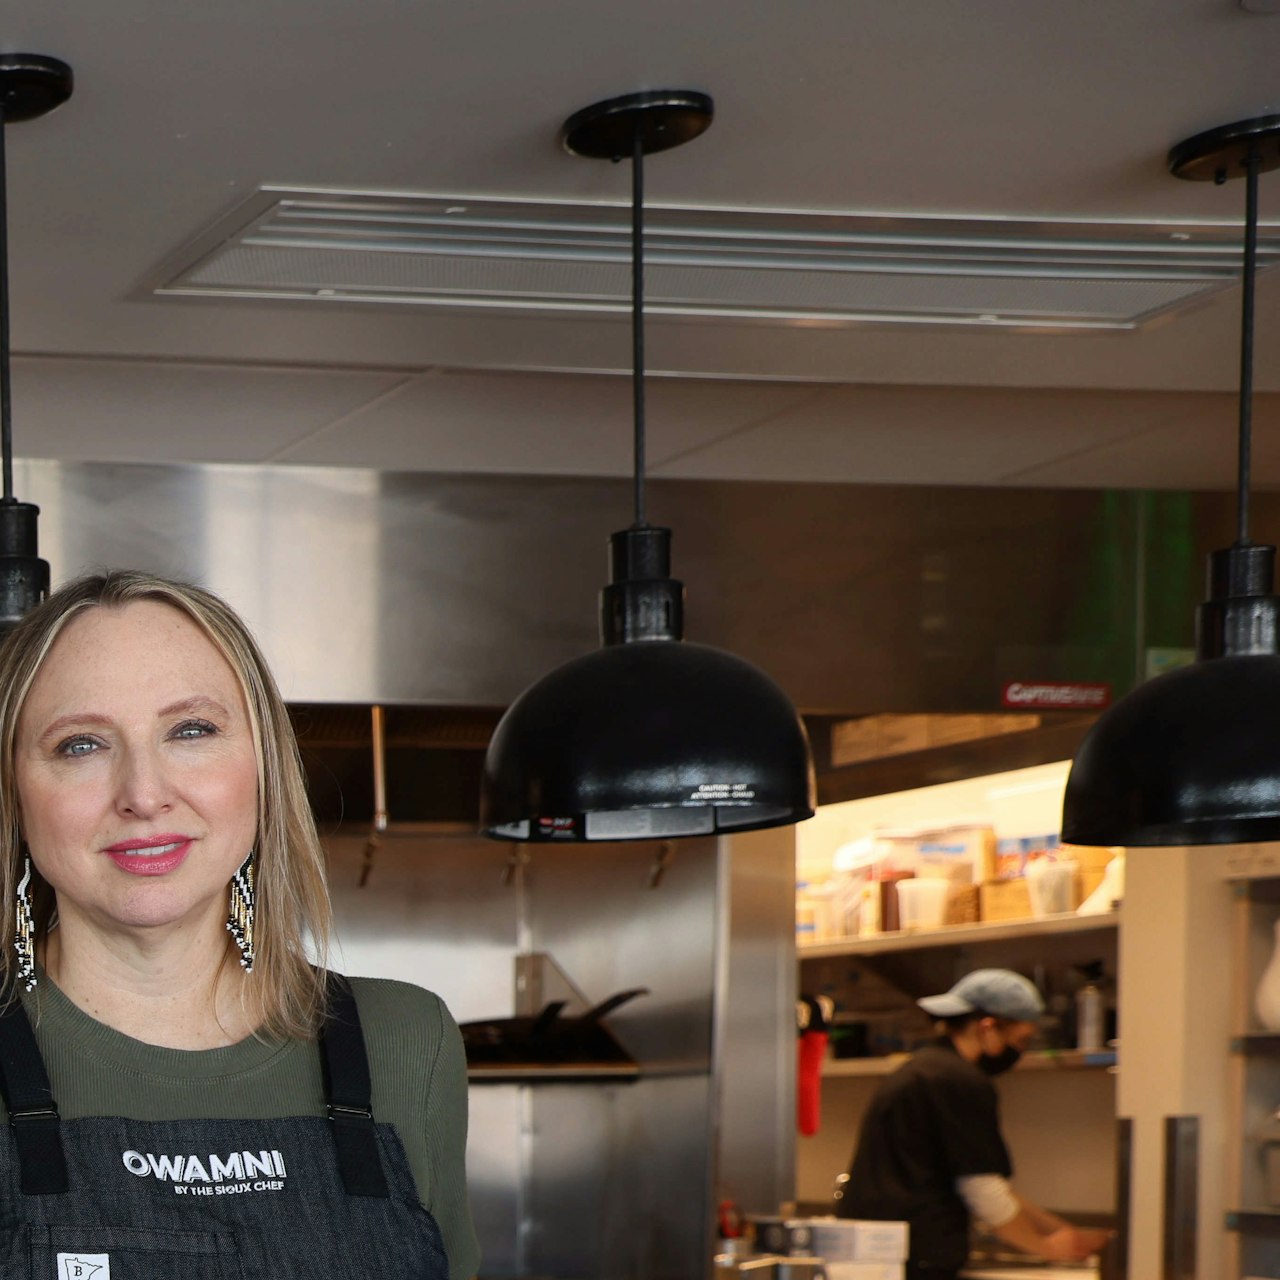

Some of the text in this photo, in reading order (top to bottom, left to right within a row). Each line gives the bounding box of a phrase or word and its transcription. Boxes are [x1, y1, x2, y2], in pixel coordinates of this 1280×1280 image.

[122, 1149, 287, 1183] OWAMNI
[174, 1181, 285, 1196] BY THE SIOUX CHEF
[74, 1265, 83, 1277] B
